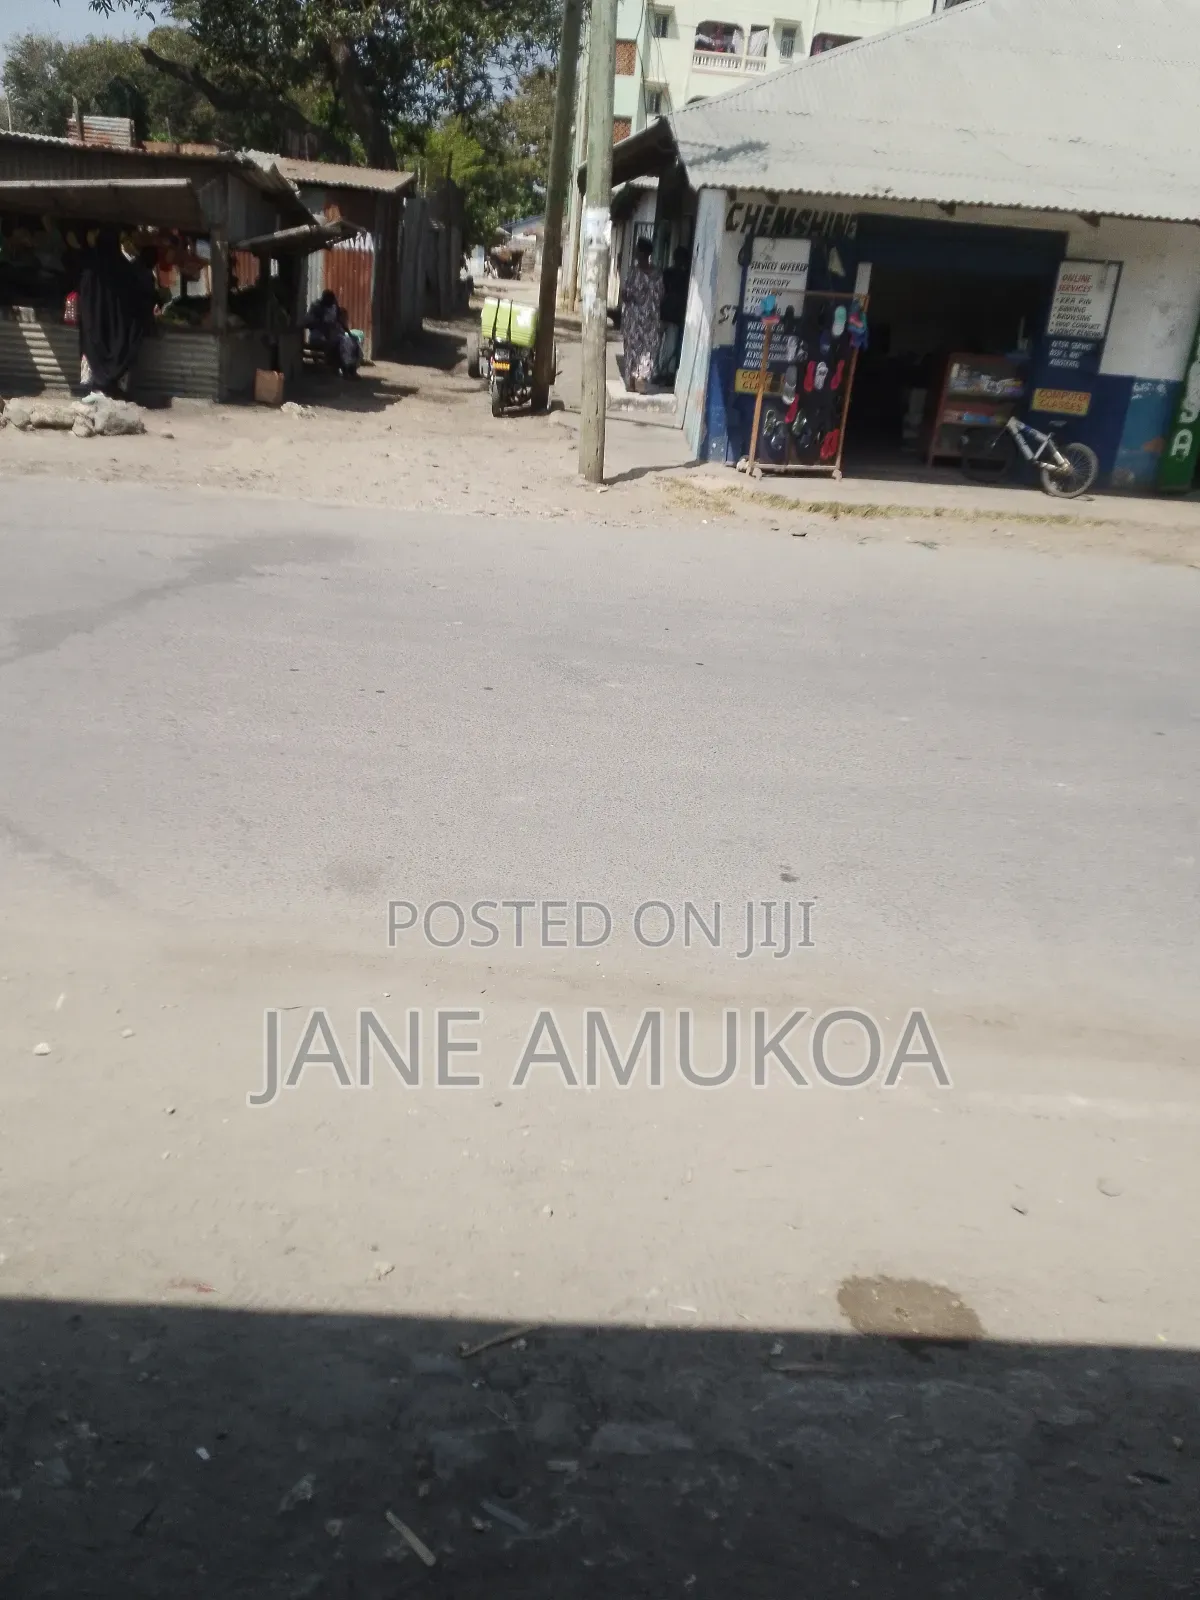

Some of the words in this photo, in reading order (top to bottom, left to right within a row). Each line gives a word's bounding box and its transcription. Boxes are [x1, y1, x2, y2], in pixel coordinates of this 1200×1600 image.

[752, 278, 791, 287] PHOTOCOPY
[1062, 273, 1093, 283] ONLINE
[1058, 284, 1094, 293] SERVICES
